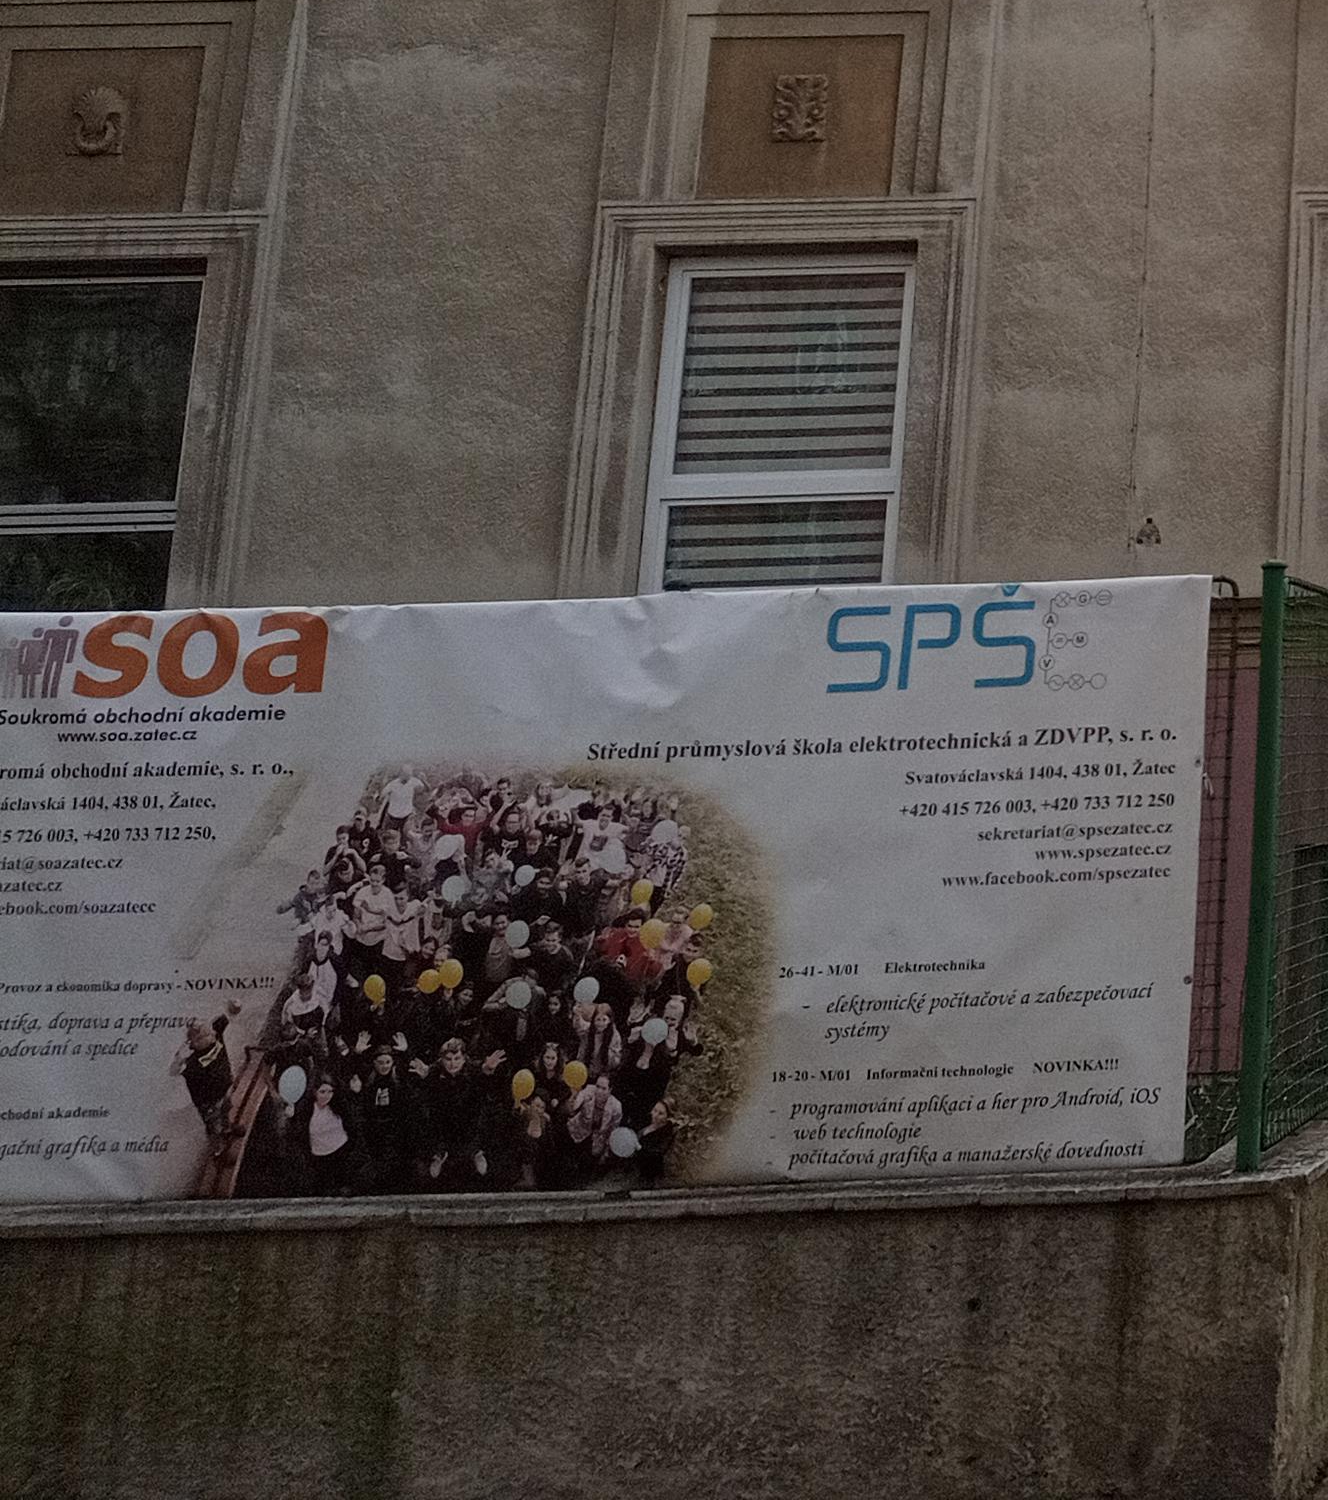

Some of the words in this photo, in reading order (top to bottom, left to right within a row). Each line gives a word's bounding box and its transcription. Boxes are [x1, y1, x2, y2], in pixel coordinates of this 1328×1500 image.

[826, 584, 1036, 693] SPŠ
[72, 611, 330, 699] soa
[0, 708, 87, 725] Soukromá
[94, 706, 184, 724] obchodní
[189, 704, 287, 722] akademie
[57, 729, 197, 743] www.soa.zatec.cz
[587, 741, 661, 760] Střední
[665, 739, 787, 762] průmyslová
[792, 736, 843, 756] škola
[849, 730, 1012, 753] elektrotechnická
[1018, 734, 1028, 747] a
[1033, 727, 1114, 746] ZDVPP,
[1119, 730, 1134, 743] s.
[1140, 729, 1154, 742] r.
[1160, 729, 1177, 741] o.
[51, 761, 128, 779] obchodní
[132, 760, 224, 779] akademie,
[230, 763, 245, 776] s.
[252, 763, 265, 776] r.
[905, 767, 1023, 785] Svatováclavská
[1071, 763, 1100, 778] 438
[1105, 763, 1128, 778] 01,
[1132, 757, 1176, 775] Žatec
[112, 795, 138, 810] 438
[142, 795, 164, 811] 01,
[899, 802, 938, 817] +420
[942, 801, 969, 816] 415
[974, 800, 1001, 815] 726
[1040, 796, 1079, 811] +420
[1083, 795, 1110, 810] 733
[1116, 794, 1143, 808] 712
[1147, 793, 1175, 807] 250
[16, 828, 42, 843] 726
[83, 827, 120, 842] +420
[125, 827, 149, 842] 733
[155, 826, 180, 841] 712
[977, 822, 1173, 841] sekretariat@spsezatec.cz
[1034, 842, 1172, 861] www.spsezatec.cz
[0, 856, 123, 874] iat@soazatec.cz
[942, 865, 1171, 887] www.facebook.com/spsezatec
[0, 881, 63, 893] zatec.cz
[884, 959, 986, 975] Elektrotechnika
[45, 983, 53, 993] a
[124, 980, 174, 994] dopravy
[184, 976, 275, 991] NOVINKA!!!
[826, 992, 927, 1016] elektronické
[927, 988, 1018, 1015] počítačové
[1020, 992, 1030, 1006] a
[1033, 981, 1155, 1007] zabezpečovací
[48, 1011, 110, 1035] doprava
[114, 1016, 124, 1030] a
[125, 1013, 197, 1035] přeprava
[824, 1020, 890, 1044] systémy
[85, 1038, 139, 1060] spedice
[866, 1065, 939, 1081] Informační
[941, 1063, 1014, 1078] technologie
[1032, 1057, 1120, 1074] NOVINKA!!!
[47, 1105, 111, 1119] akademie
[790, 1097, 904, 1120] programování
[977, 1099, 987, 1111] a
[991, 1091, 1019, 1111] her
[1020, 1098, 1049, 1114] pro
[1050, 1086, 1124, 1109] Android,
[1129, 1086, 1162, 1105] iOS
[793, 1121, 827, 1141] web
[831, 1121, 922, 1144] technologie
[43, 1134, 107, 1161] grafika
[124, 1134, 170, 1154] média
[788, 1146, 874, 1170] počítačová
[877, 1144, 937, 1169] grafika
[942, 1150, 952, 1163] a
[957, 1141, 1053, 1164] manažerské
[1055, 1139, 1145, 1160] dovednosti
